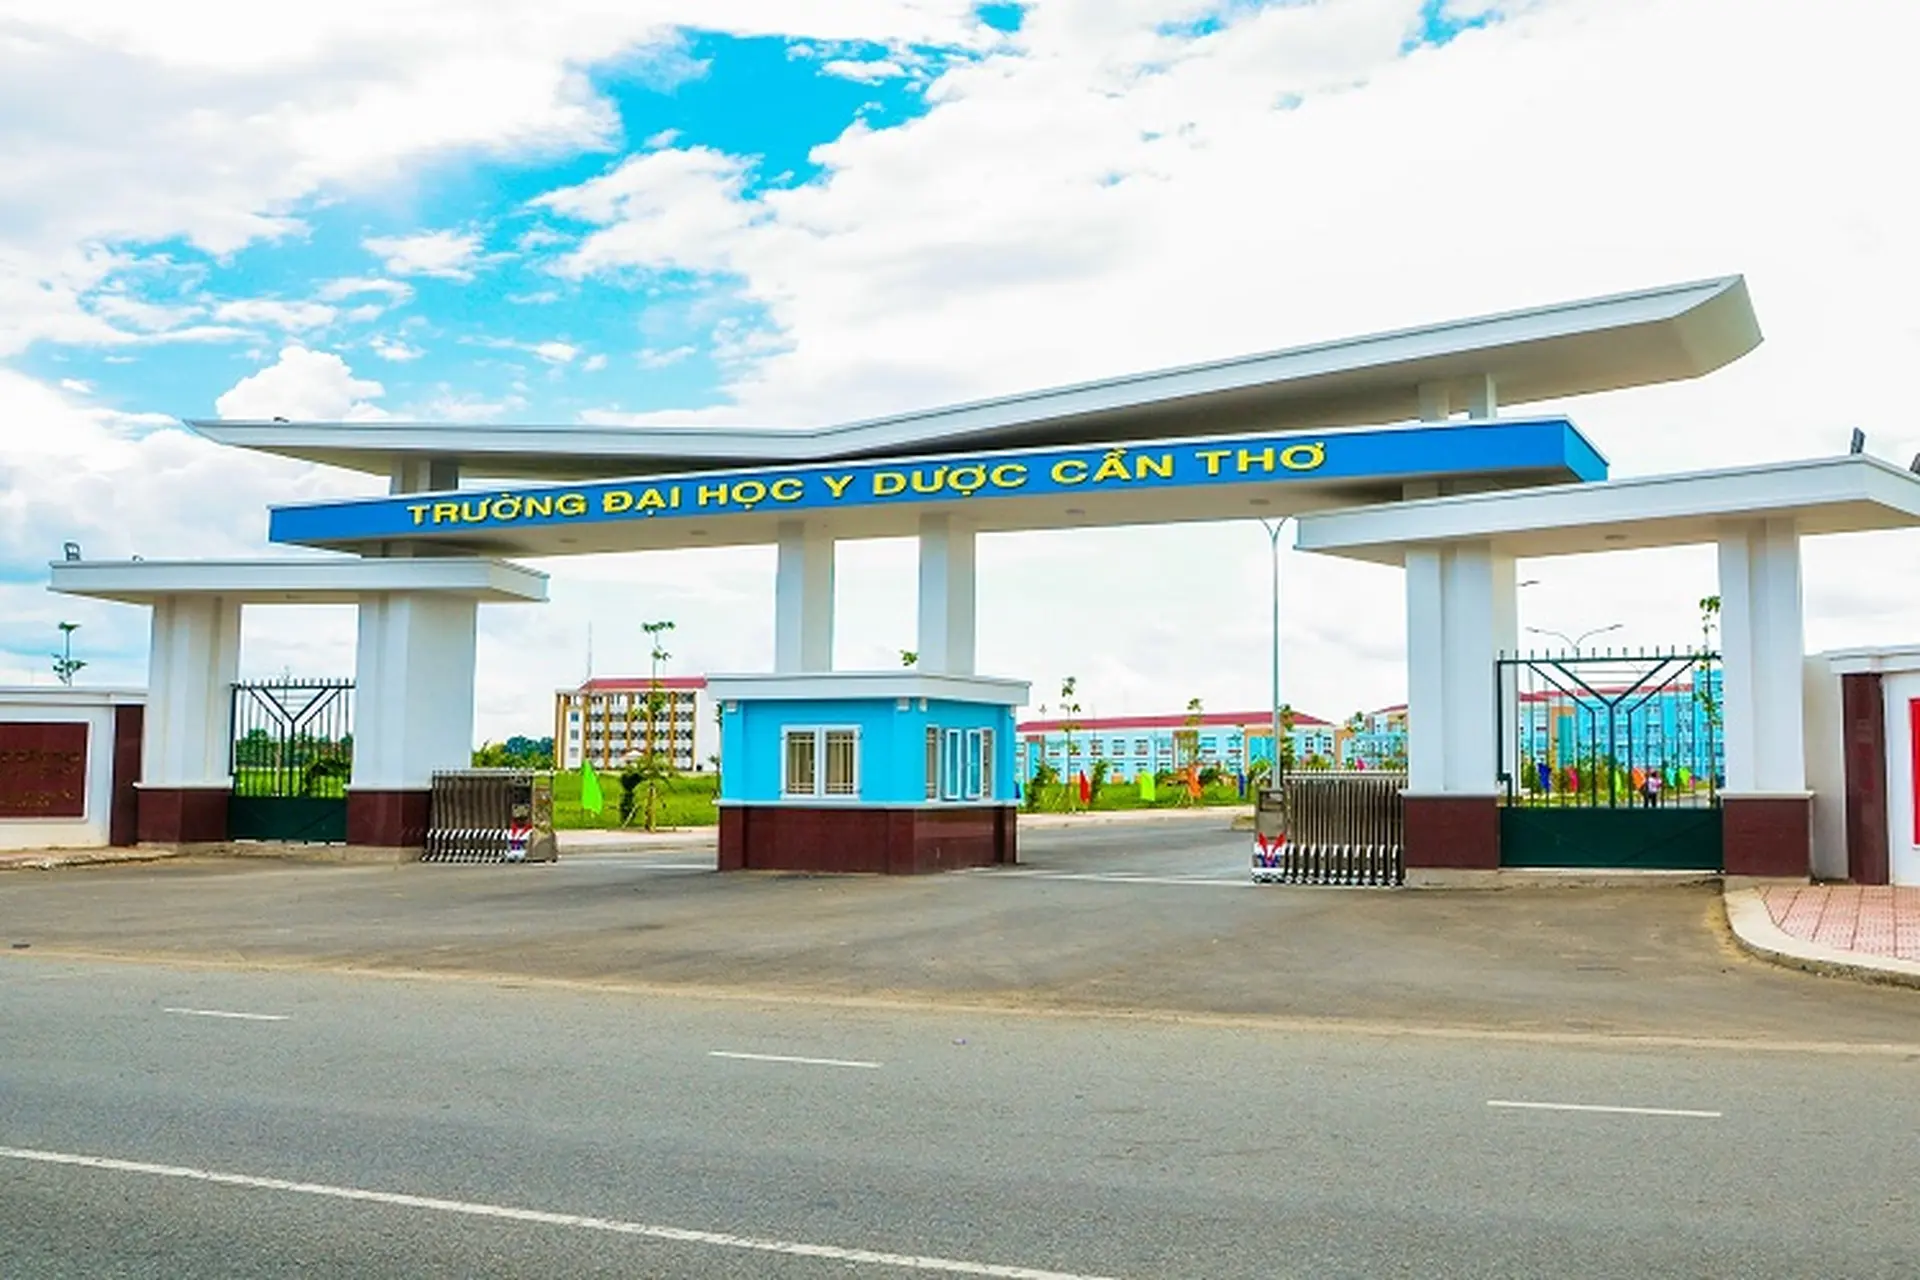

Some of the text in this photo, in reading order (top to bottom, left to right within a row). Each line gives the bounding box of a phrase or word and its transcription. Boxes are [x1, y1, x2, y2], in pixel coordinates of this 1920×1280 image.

[407, 493, 586, 525] TRƯỜNG
[603, 487, 680, 516] ĐẠI
[697, 478, 803, 510] HỌC
[823, 475, 855, 498] Y
[872, 464, 1028, 496] DƯỢC
[1196, 442, 1327, 474] THƠ
